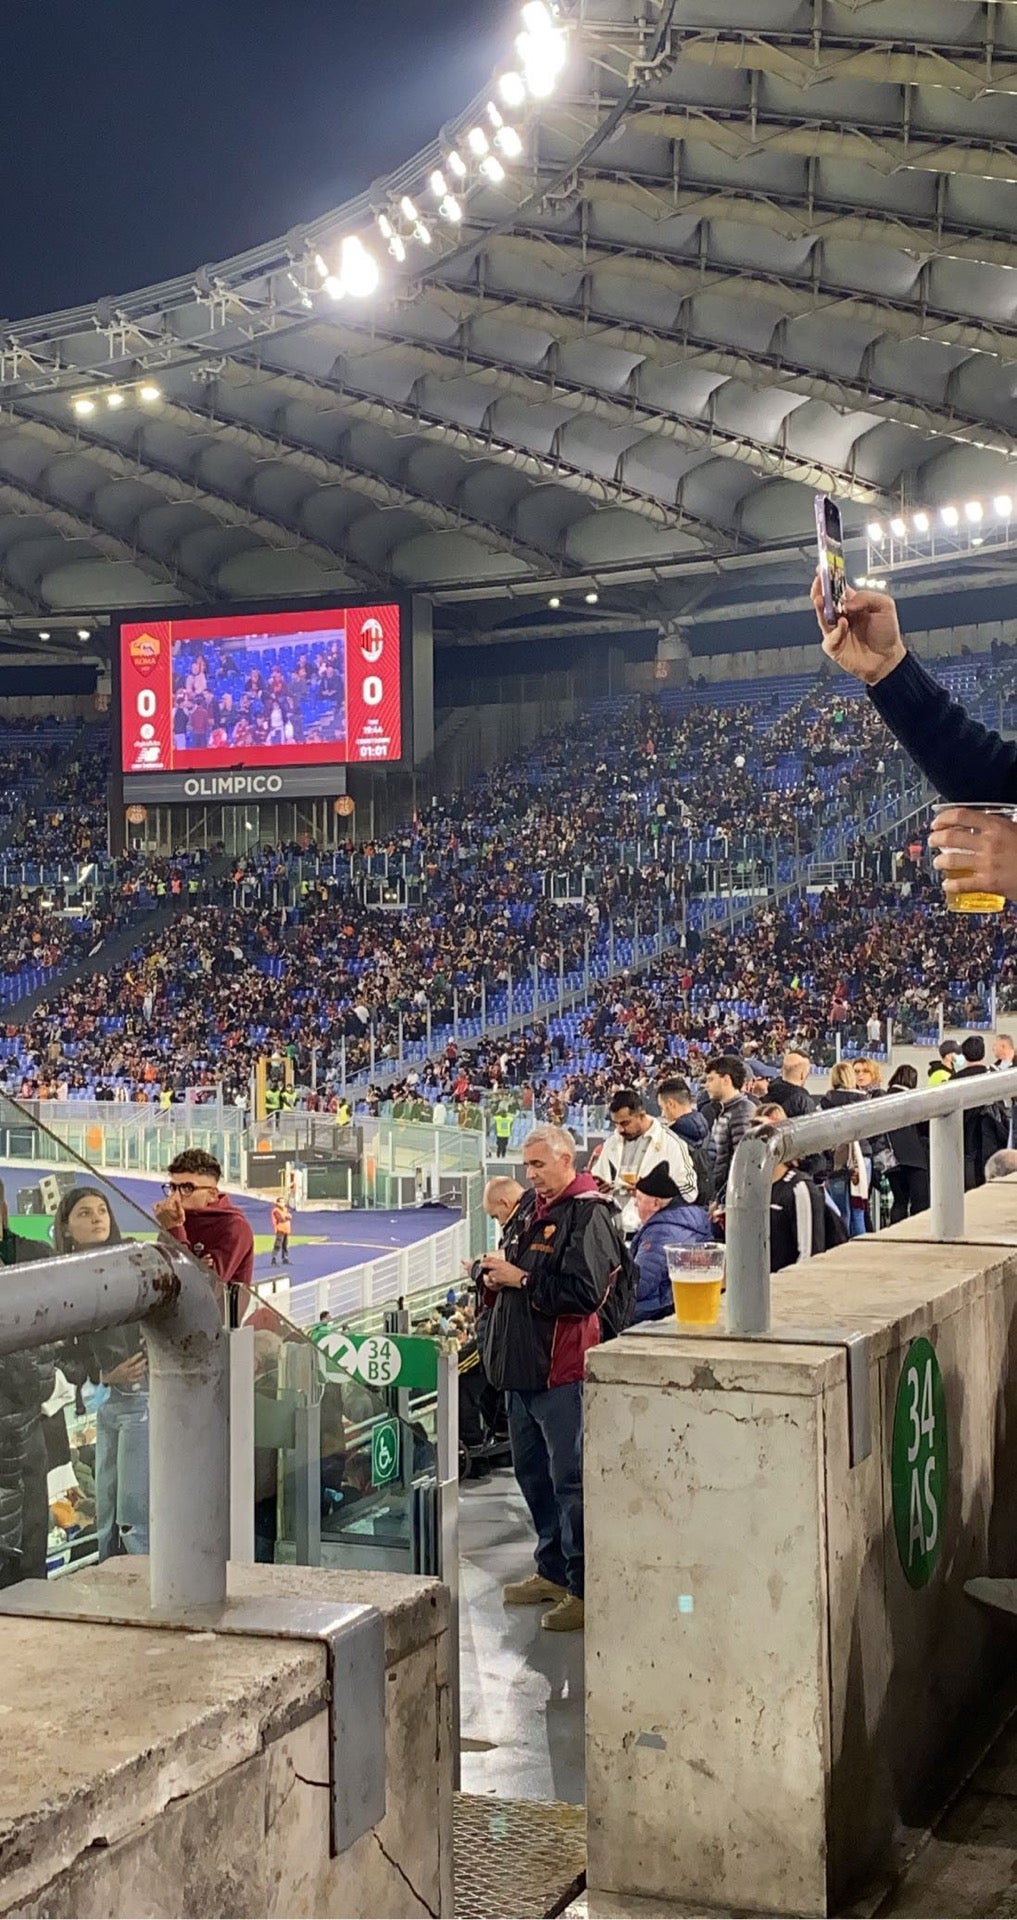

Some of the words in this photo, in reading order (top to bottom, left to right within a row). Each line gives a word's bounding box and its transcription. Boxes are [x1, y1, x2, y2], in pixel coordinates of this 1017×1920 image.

[137, 688, 156, 717] 0
[363, 675, 383, 705] 0
[360, 745, 387, 757] 01:01
[184, 775, 282, 796] OLIMPICO
[368, 1340, 391, 1360] 34
[368, 1361, 391, 1380] BS
[907, 1358, 936, 1463] 34
[908, 1455, 938, 1567] AS
